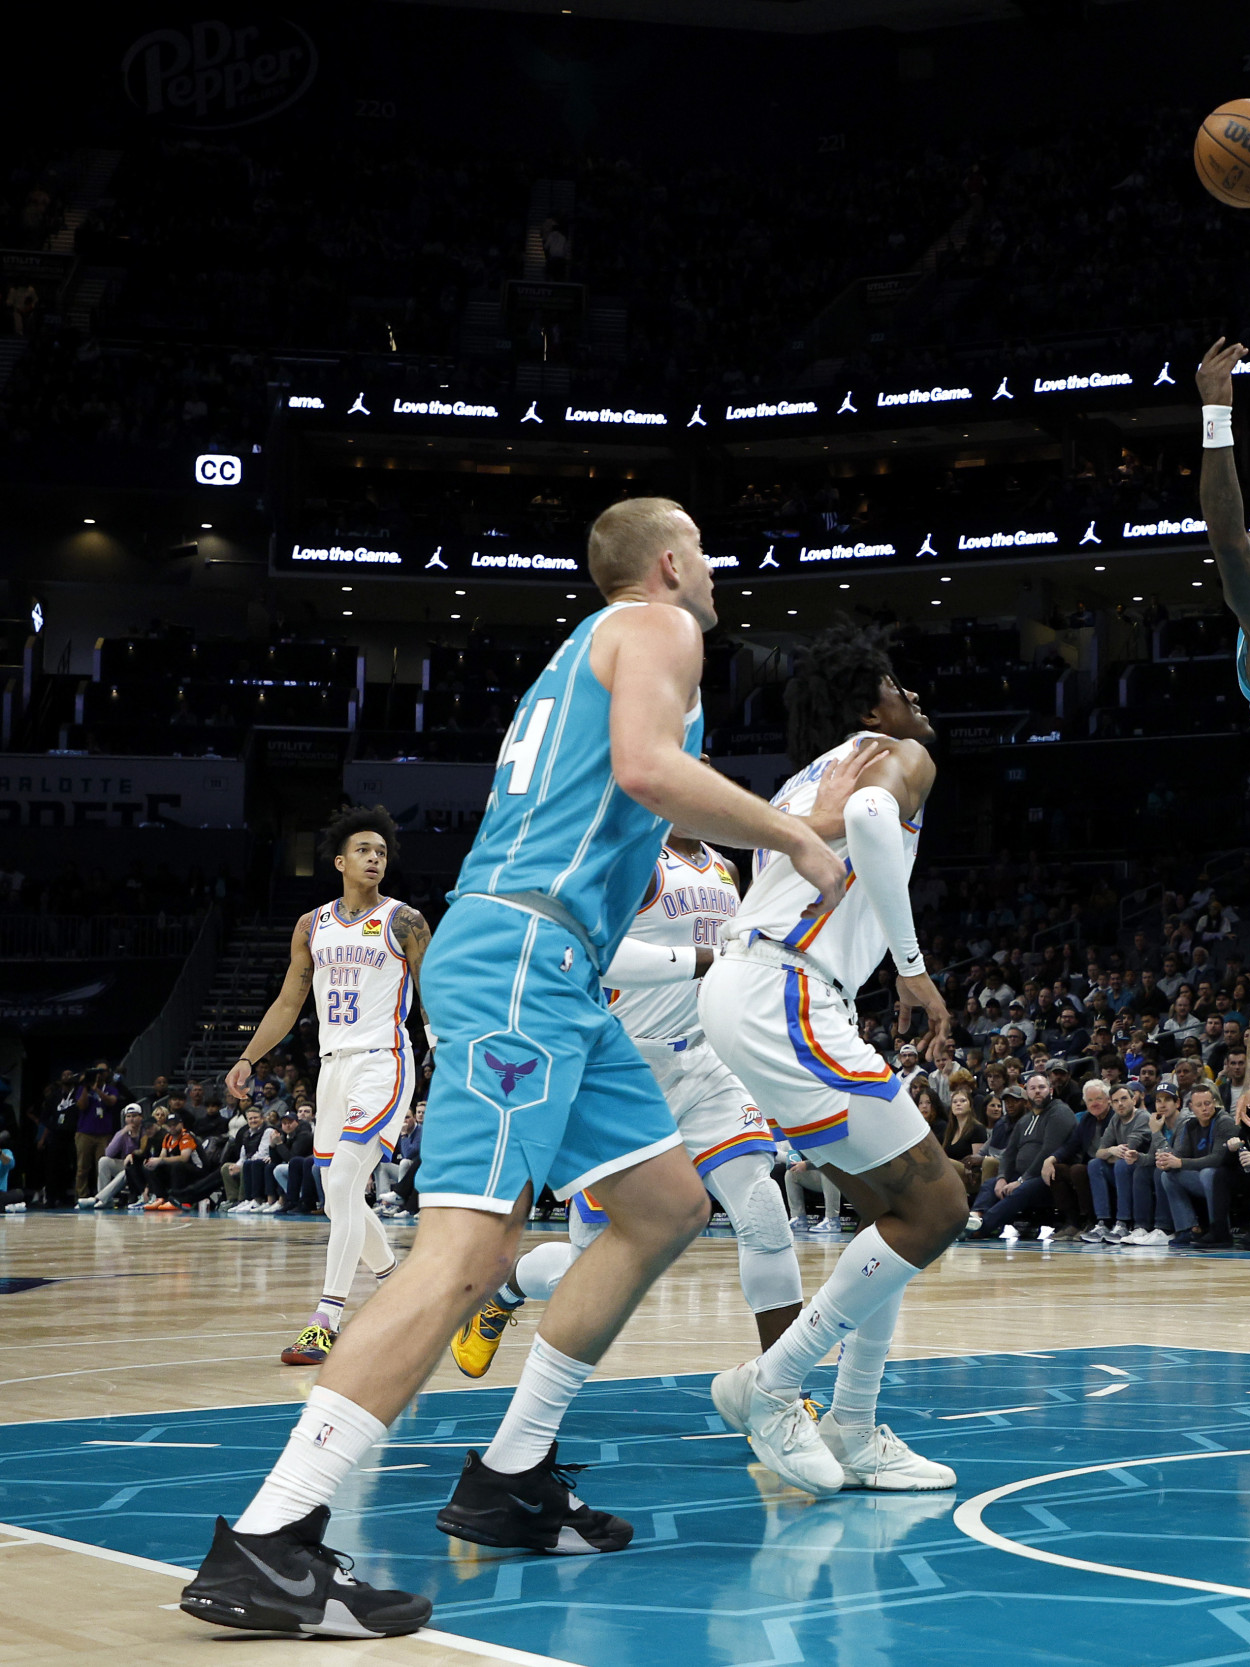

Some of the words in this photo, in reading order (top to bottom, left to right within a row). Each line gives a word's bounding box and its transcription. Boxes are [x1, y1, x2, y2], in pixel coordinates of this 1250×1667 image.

[192, 20, 259, 68] Dr
[122, 28, 303, 116] Pepper
[1034, 379, 1066, 392] Love
[1066, 375, 1089, 389] the
[1089, 373, 1132, 387] Game.
[878, 393, 908, 406] Love
[909, 390, 930, 403] the
[930, 388, 972, 401] Game.
[394, 399, 428, 413] Love
[429, 401, 452, 414] the
[453, 402, 498, 417] Game.
[566, 407, 599, 421] Love
[600, 409, 623, 422] the
[623, 410, 667, 424] Game.
[726, 406, 756, 419] Love
[756, 403, 777, 417] the
[777, 401, 817, 415] Game.
[201, 461, 236, 481] CC
[1123, 523, 1157, 537] Love
[1158, 520, 1181, 534] the
[959, 536, 991, 549] Love
[992, 533, 1014, 547] the
[1014, 531, 1058, 545] Game.
[292, 545, 328, 560] Love
[329, 547, 354, 561] the
[354, 548, 401, 563] Game.
[472, 552, 507, 567] Love
[508, 554, 530, 568] the
[530, 555, 577, 569] Game.
[800, 548, 831, 561] Love
[832, 545, 854, 559] the
[854, 543, 895, 557] Game.
[950, 728, 991, 737] UTILITY
[267, 741, 313, 751] UTILITY
[661, 886, 741, 919] OKLAHOM
[692, 917, 727, 945] CIT
[330, 967, 360, 986] CITY
[328, 989, 360, 1026] 23
